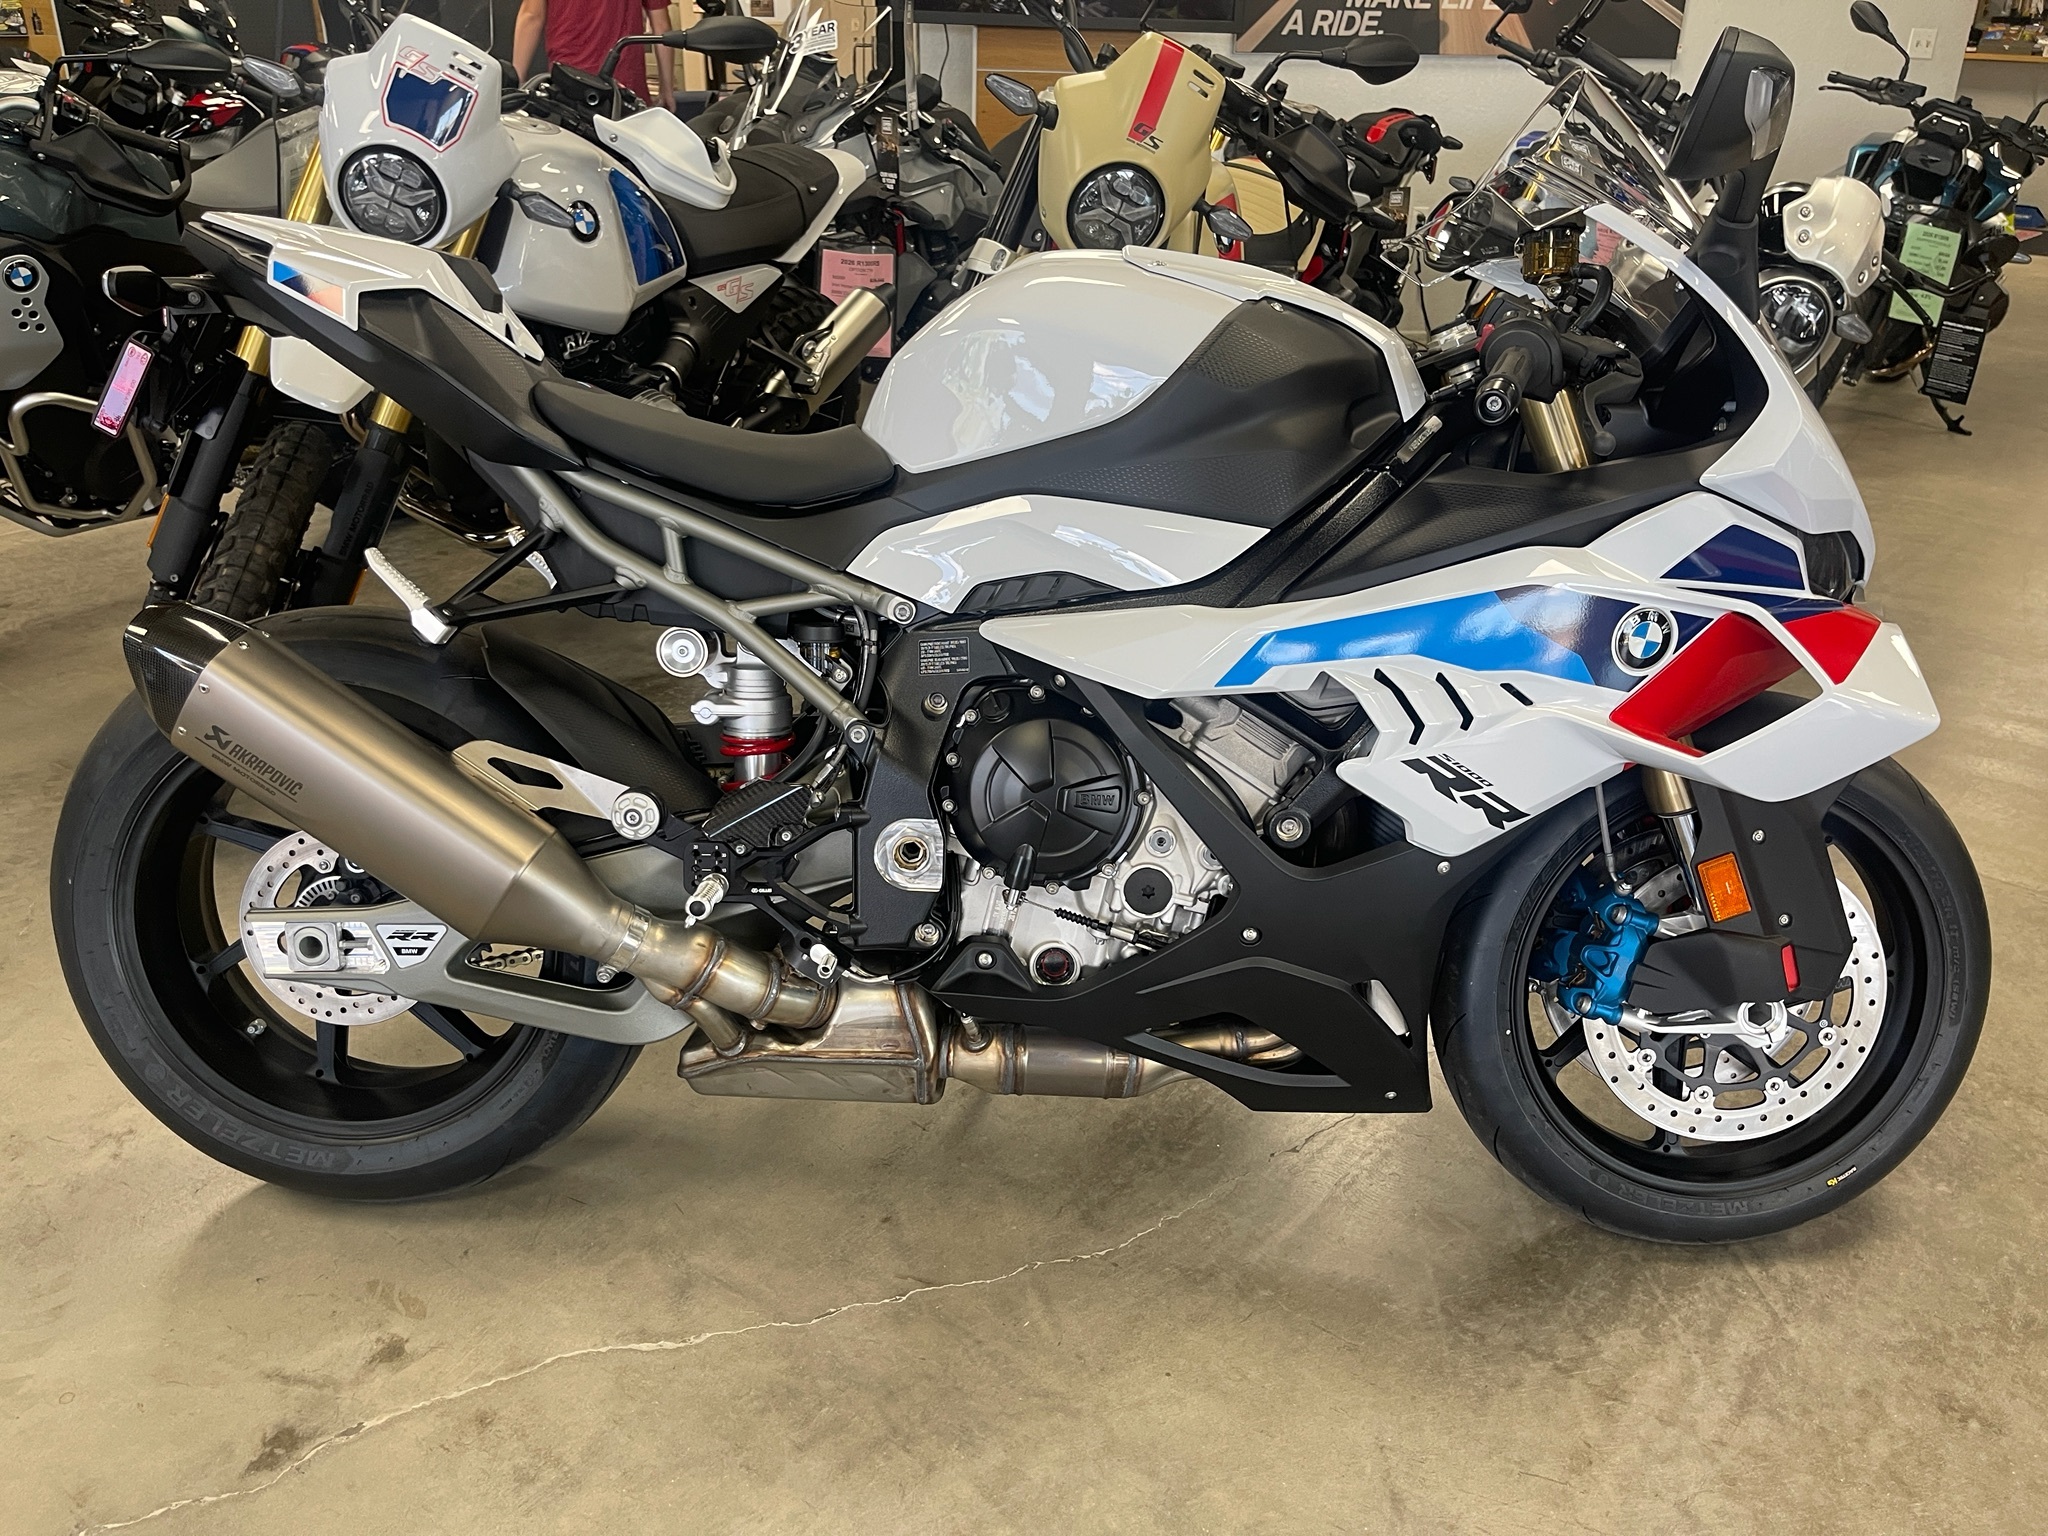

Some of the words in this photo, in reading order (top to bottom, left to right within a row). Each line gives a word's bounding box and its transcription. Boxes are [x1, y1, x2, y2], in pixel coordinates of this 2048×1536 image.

[804, 21, 836, 38] YEAR
[1281, 9, 1304, 36] A
[1310, 11, 1385, 36] RIDE.
[1438, 753, 1495, 788] S1000
[1080, 793, 1116, 806] BMW
[1400, 755, 1531, 830] RR
[386, 931, 439, 942] RR
[166, 1083, 337, 1170] METZELER
[1617, 1182, 1752, 1217] METZELER
